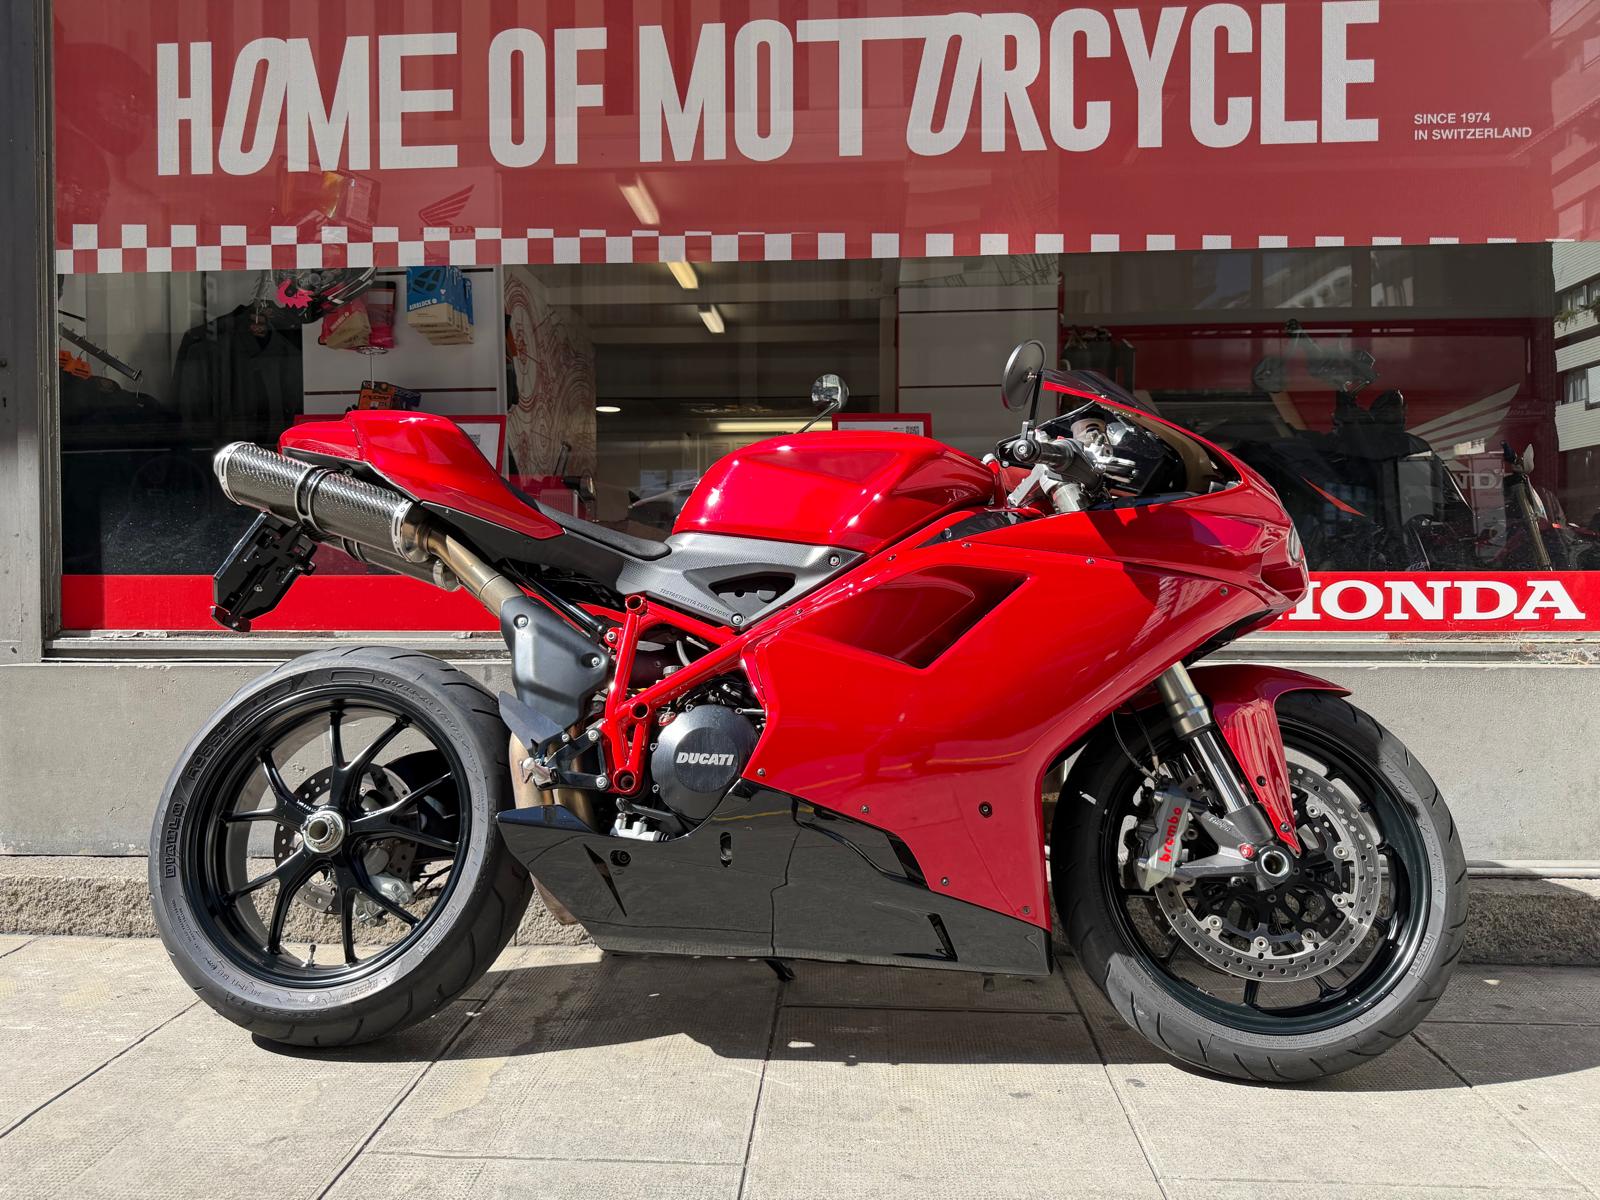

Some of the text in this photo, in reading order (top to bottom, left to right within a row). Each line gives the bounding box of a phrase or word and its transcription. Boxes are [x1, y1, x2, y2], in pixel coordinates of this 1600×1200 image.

[157, 0, 1379, 176] HOME OF MOTORCYCLE
[1414, 112, 1491, 125] SINCE 1974
[1414, 127, 1532, 141] IN SWITZERLAND
[676, 752, 734, 766] DUCATI
[165, 723, 230, 878] DIABLO ROSSO
[1158, 807, 1182, 862] brembo
